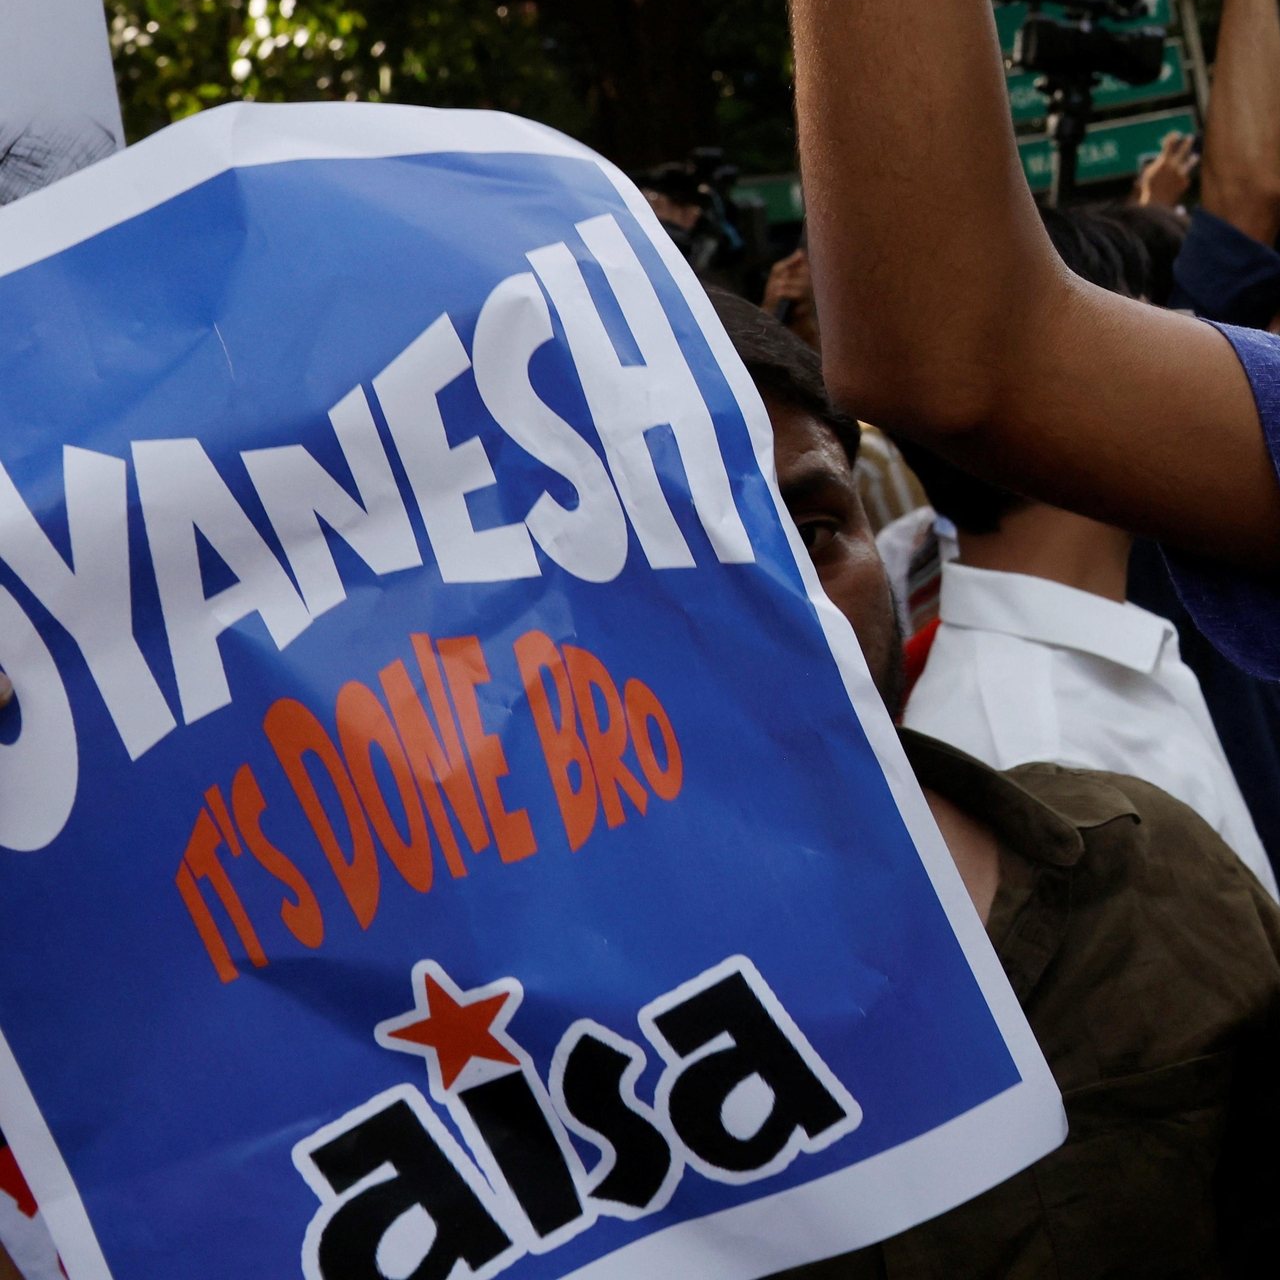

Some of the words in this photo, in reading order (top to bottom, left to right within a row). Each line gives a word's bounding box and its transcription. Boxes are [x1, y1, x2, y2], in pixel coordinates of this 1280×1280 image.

[174, 763, 324, 984] IT'S
[263, 633, 538, 931] DONE
[513, 629, 683, 853] BRO
[303, 962, 852, 1280] aisa
